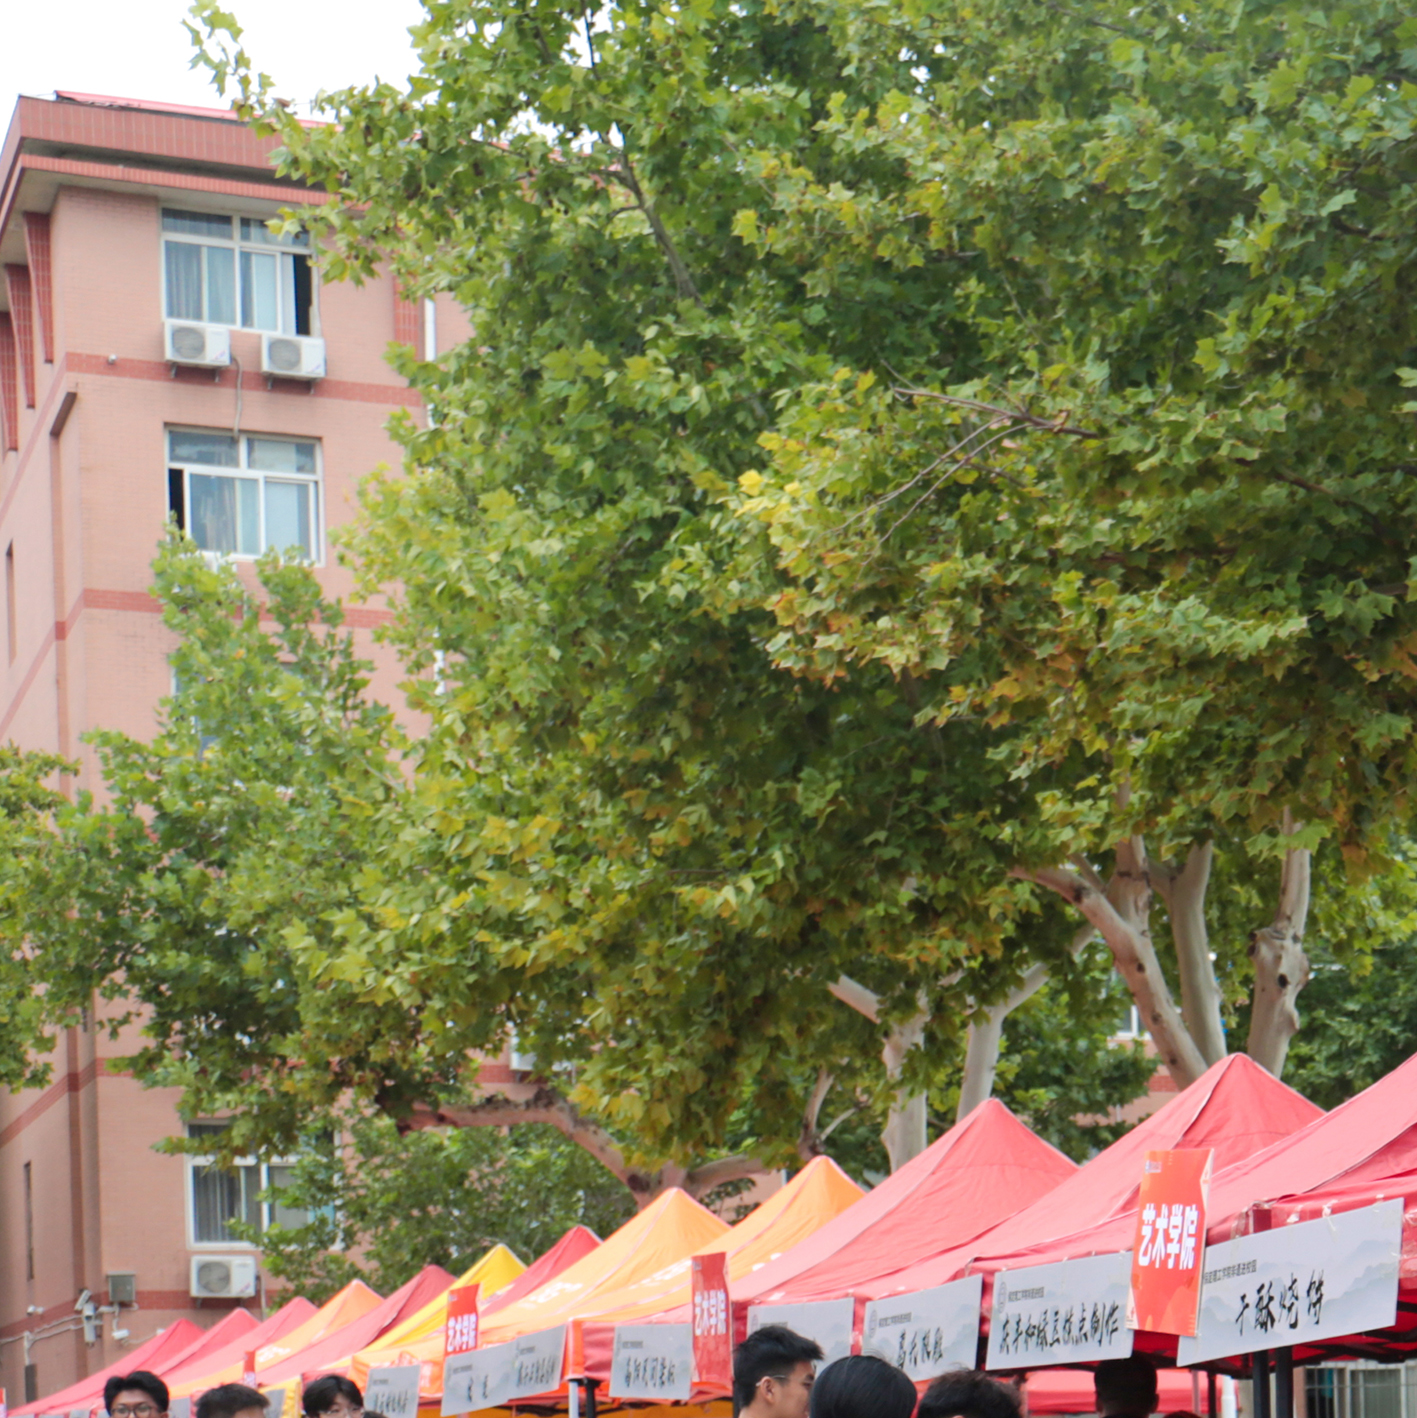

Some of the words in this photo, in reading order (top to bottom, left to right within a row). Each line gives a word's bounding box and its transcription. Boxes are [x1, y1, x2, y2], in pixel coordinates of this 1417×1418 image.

[1138, 1203, 1199, 1271] 艺术学院
[447, 1312, 478, 1352] 艺术学院
[694, 1289, 727, 1337] 艺术学院
